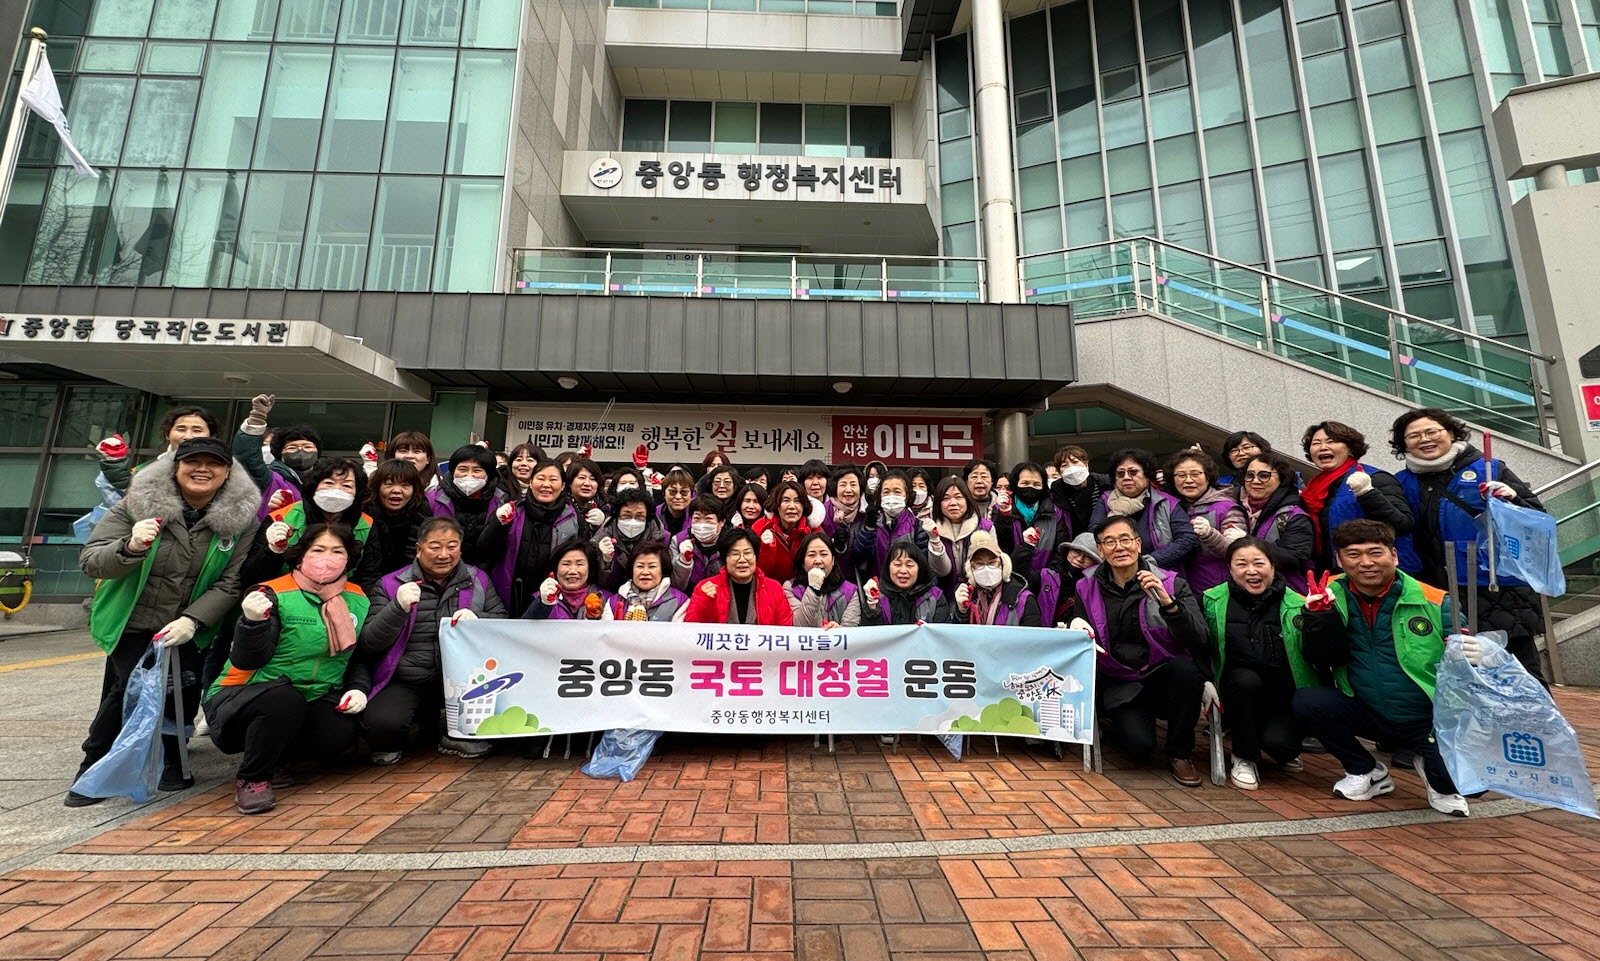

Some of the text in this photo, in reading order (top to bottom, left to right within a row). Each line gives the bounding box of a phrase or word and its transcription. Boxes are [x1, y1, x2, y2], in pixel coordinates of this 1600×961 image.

[635, 160, 902, 195] 중앙동 행정복지센터
[21, 317, 289, 344] 중앙동 당곡작은도서관
[518, 420, 544, 431] 이민청
[617, 422, 635, 433] 지점
[842, 424, 868, 439] 안산
[526, 433, 564, 449] 시민과
[641, 420, 824, 453] 행복한 설 보내세요
[873, 424, 974, 460] 이민근
[842, 442, 868, 457] 시장
[696, 633, 848, 651] 깨끗한 거리 만들기
[557, 659, 977, 699] 중앙동 국토 대청결 운동
[711, 709, 831, 725] 중앙동행정복지센터
